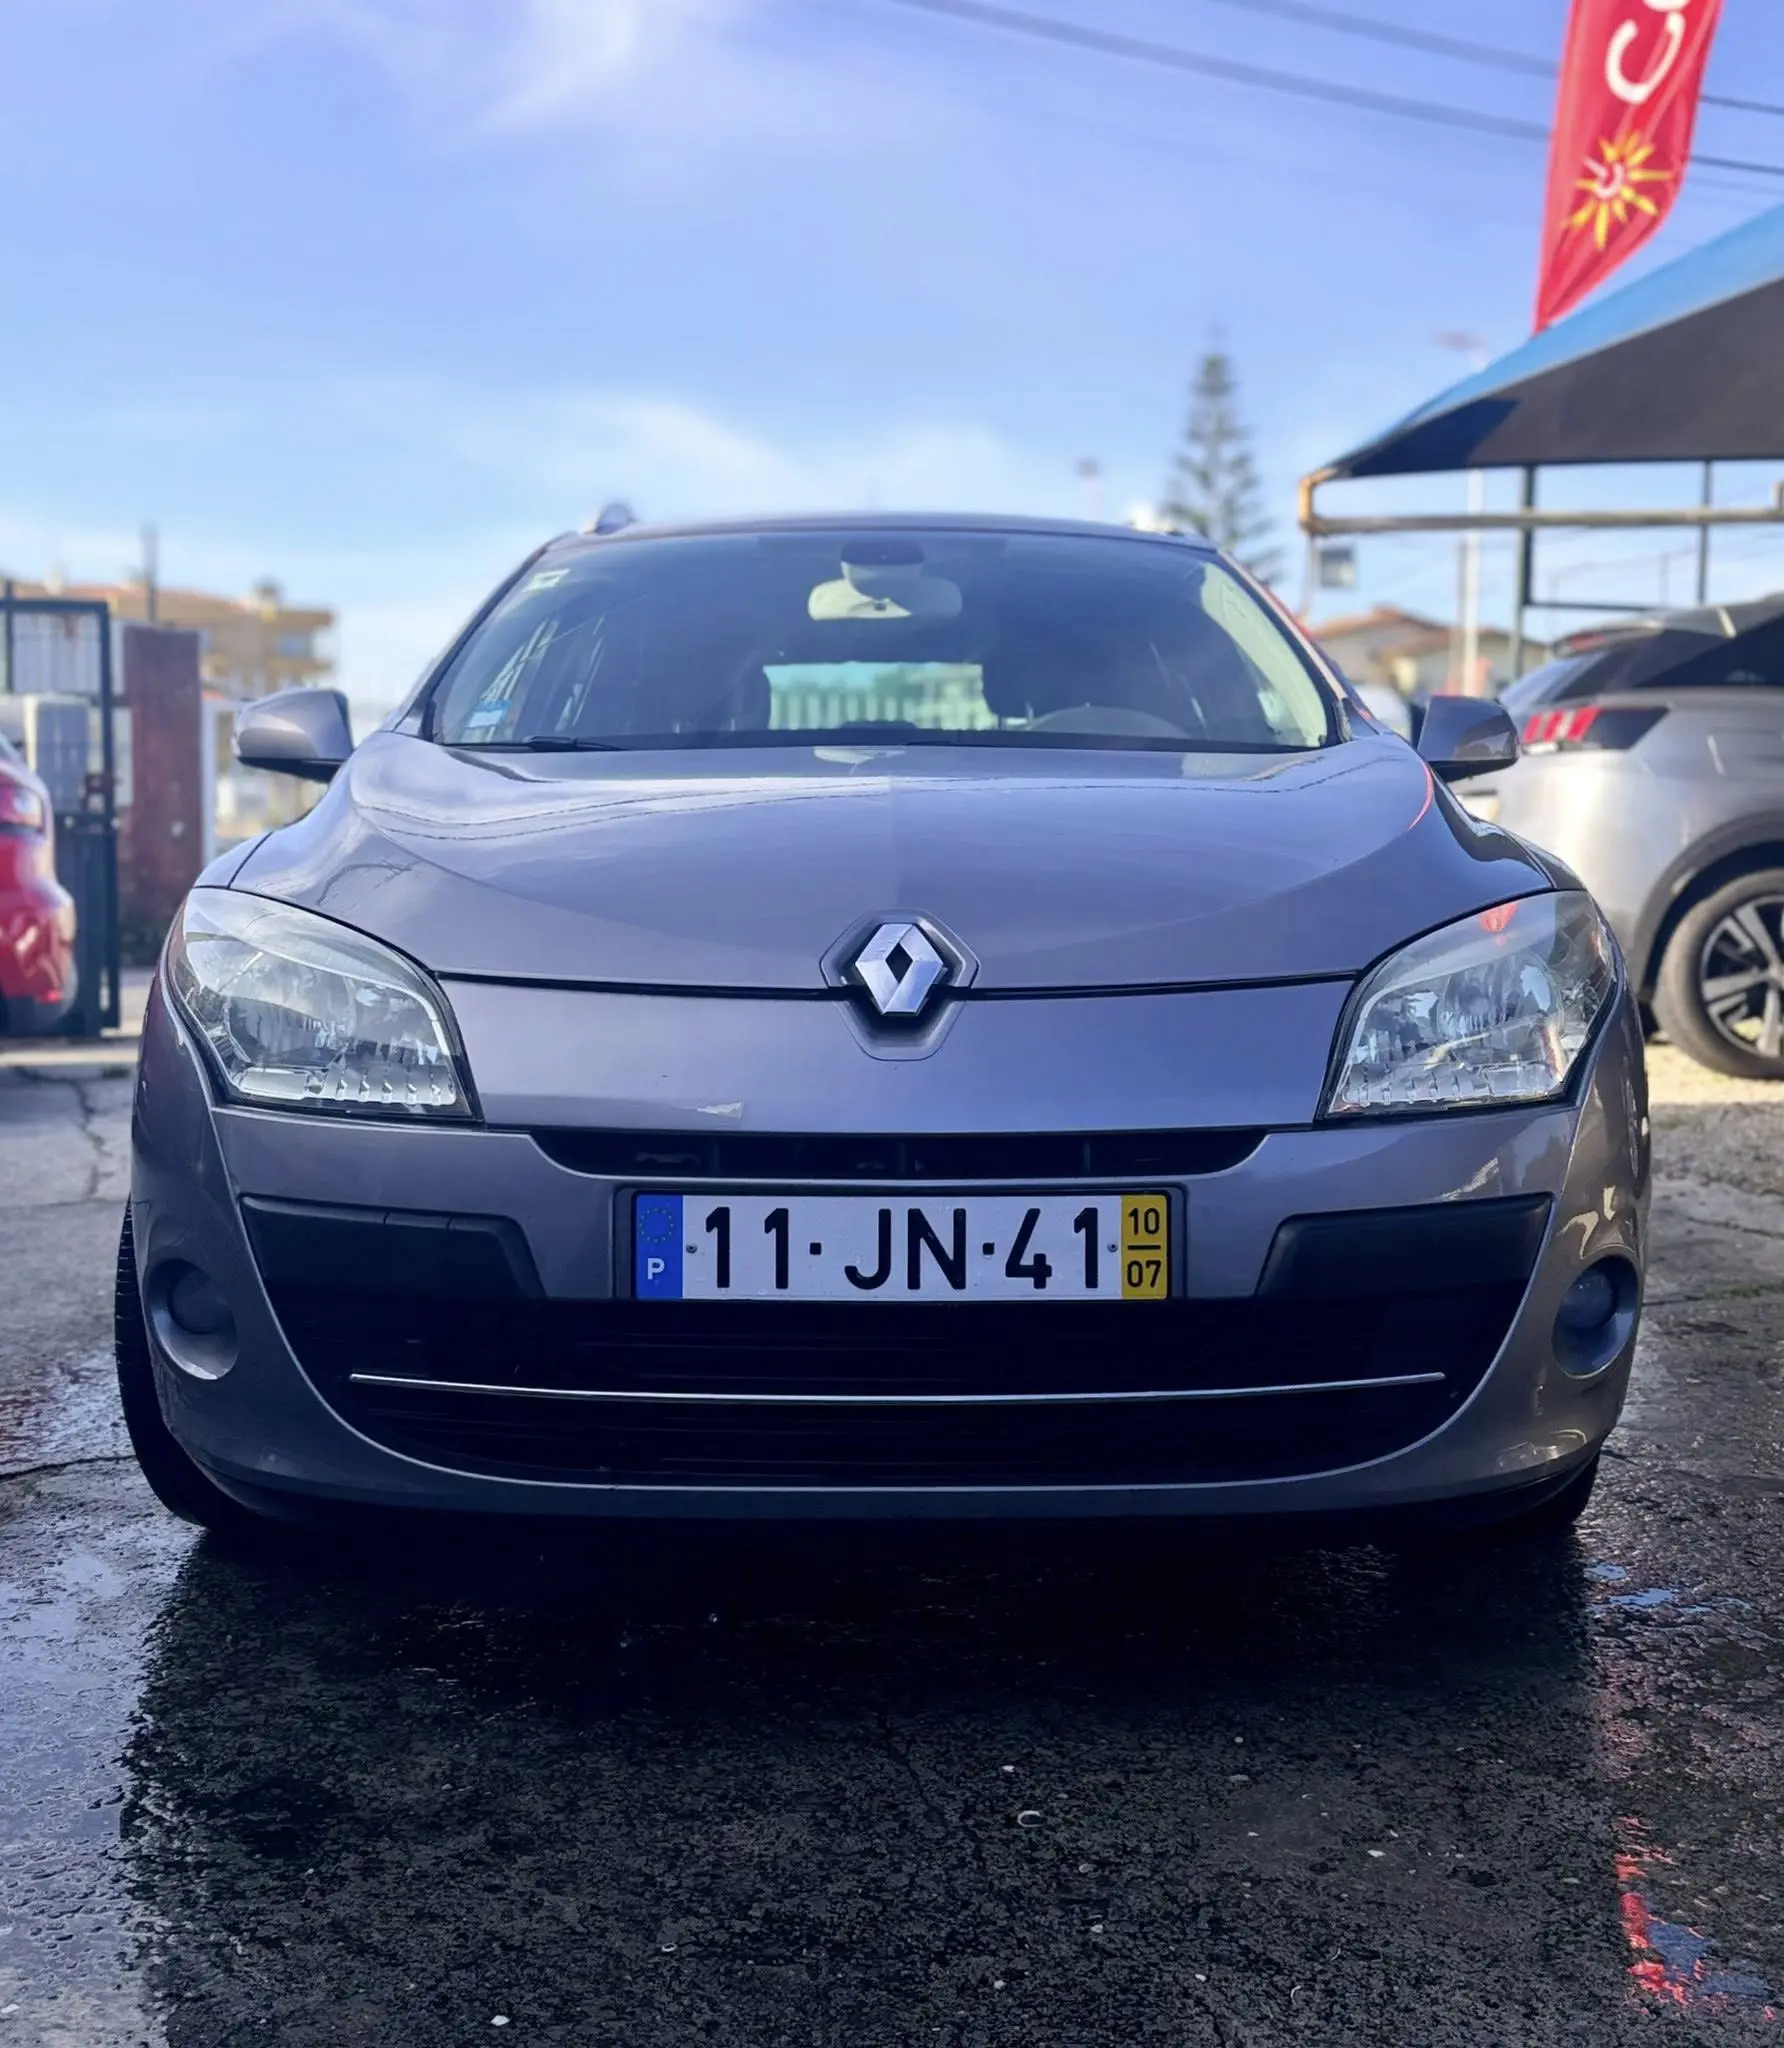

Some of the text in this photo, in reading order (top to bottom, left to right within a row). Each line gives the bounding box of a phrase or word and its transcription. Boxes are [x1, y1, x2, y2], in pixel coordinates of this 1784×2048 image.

[1605, 0, 1690, 104] C
[1128, 1207, 1160, 1235] 10
[647, 1258, 665, 1280] P
[1127, 1260, 1161, 1288] 07
